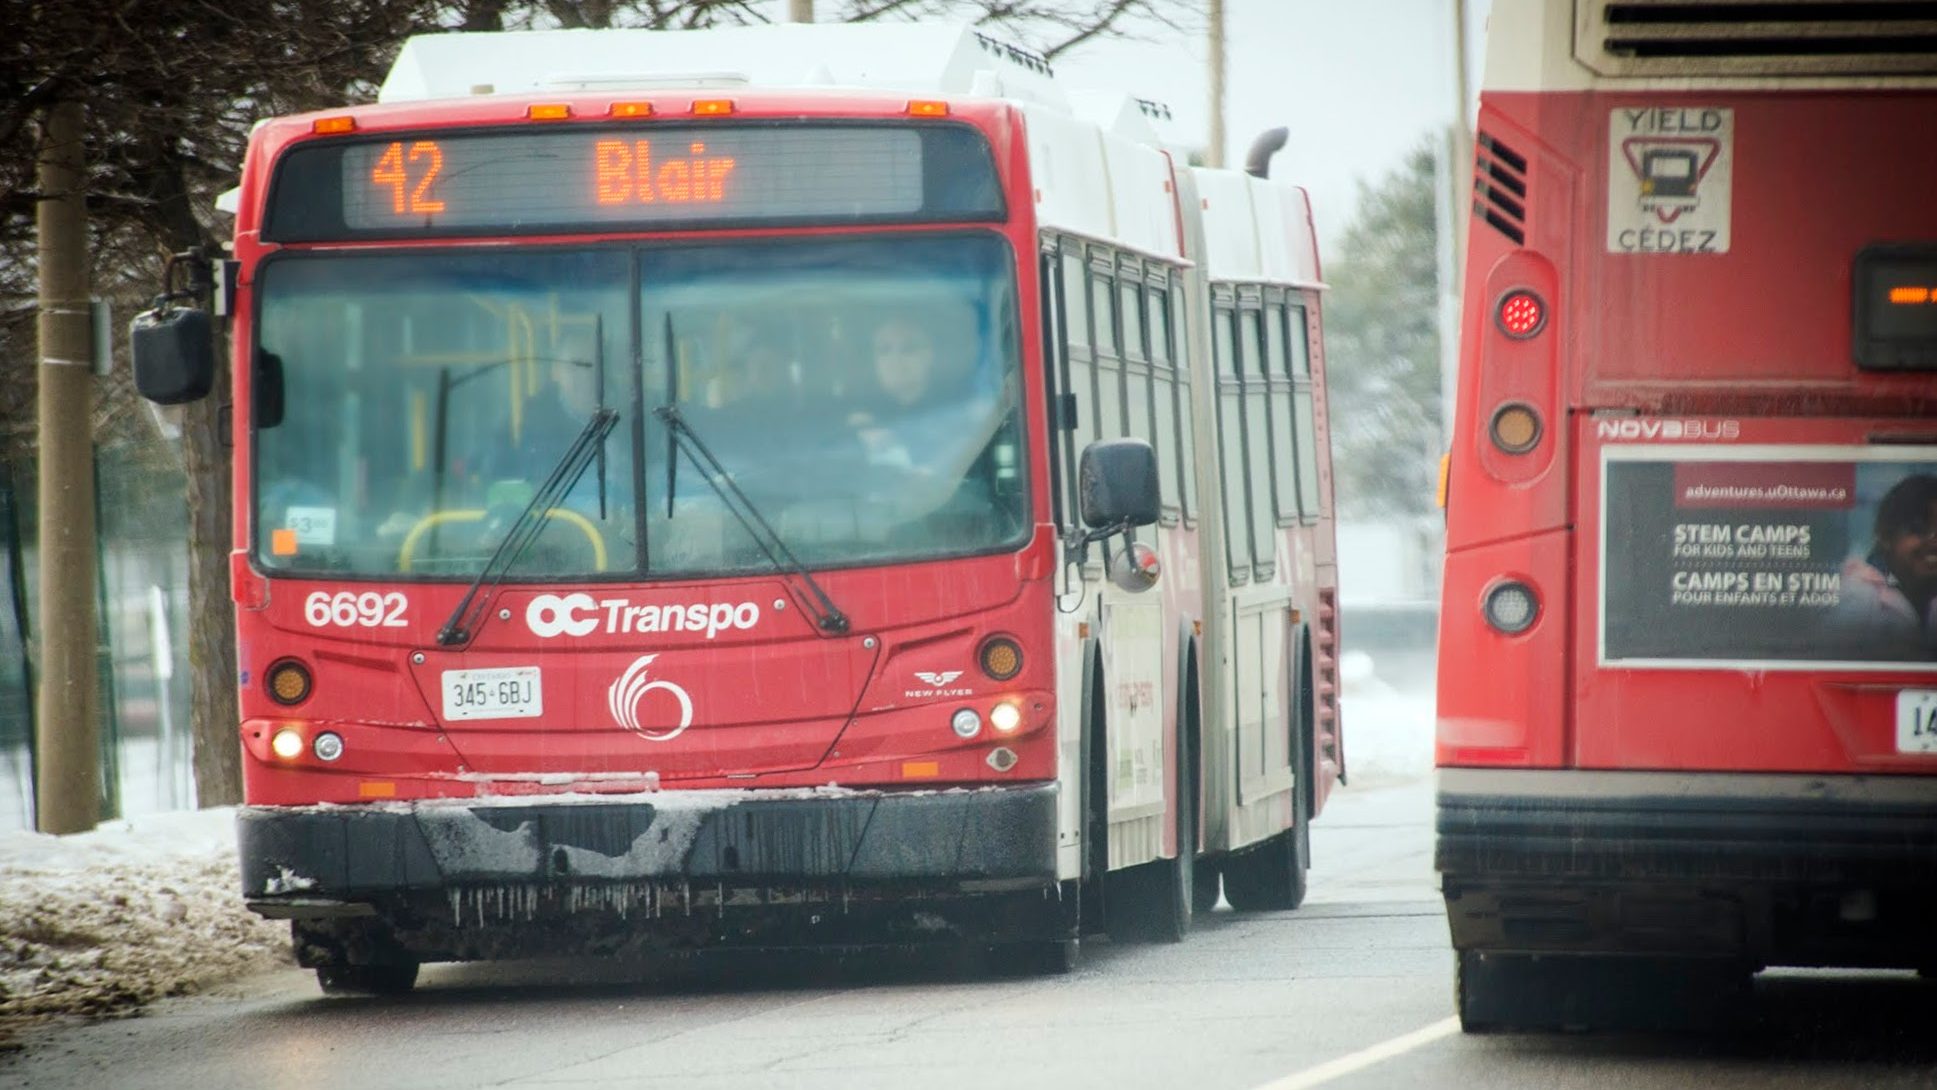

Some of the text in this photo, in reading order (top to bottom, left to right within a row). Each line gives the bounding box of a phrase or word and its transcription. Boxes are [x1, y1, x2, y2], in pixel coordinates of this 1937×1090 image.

[1624, 108, 1722, 132] YIELD
[372, 139, 735, 214] 42 Blair
[1618, 226, 1718, 252] CÉDEZ
[1686, 484, 1847, 500] adventures.uOttawa.ca
[1674, 524, 1811, 544] STEM CAMPS
[1673, 544, 1811, 558] FOR KIDS AND TEENS
[1673, 571, 1841, 591] CAMPS EN STIM
[1673, 591, 1840, 605] POUR ENFANTS ET ADOS
[304, 591, 409, 627] 6692
[525, 592, 760, 640] OC Transpo
[904, 688, 973, 698] NEW FLYER
